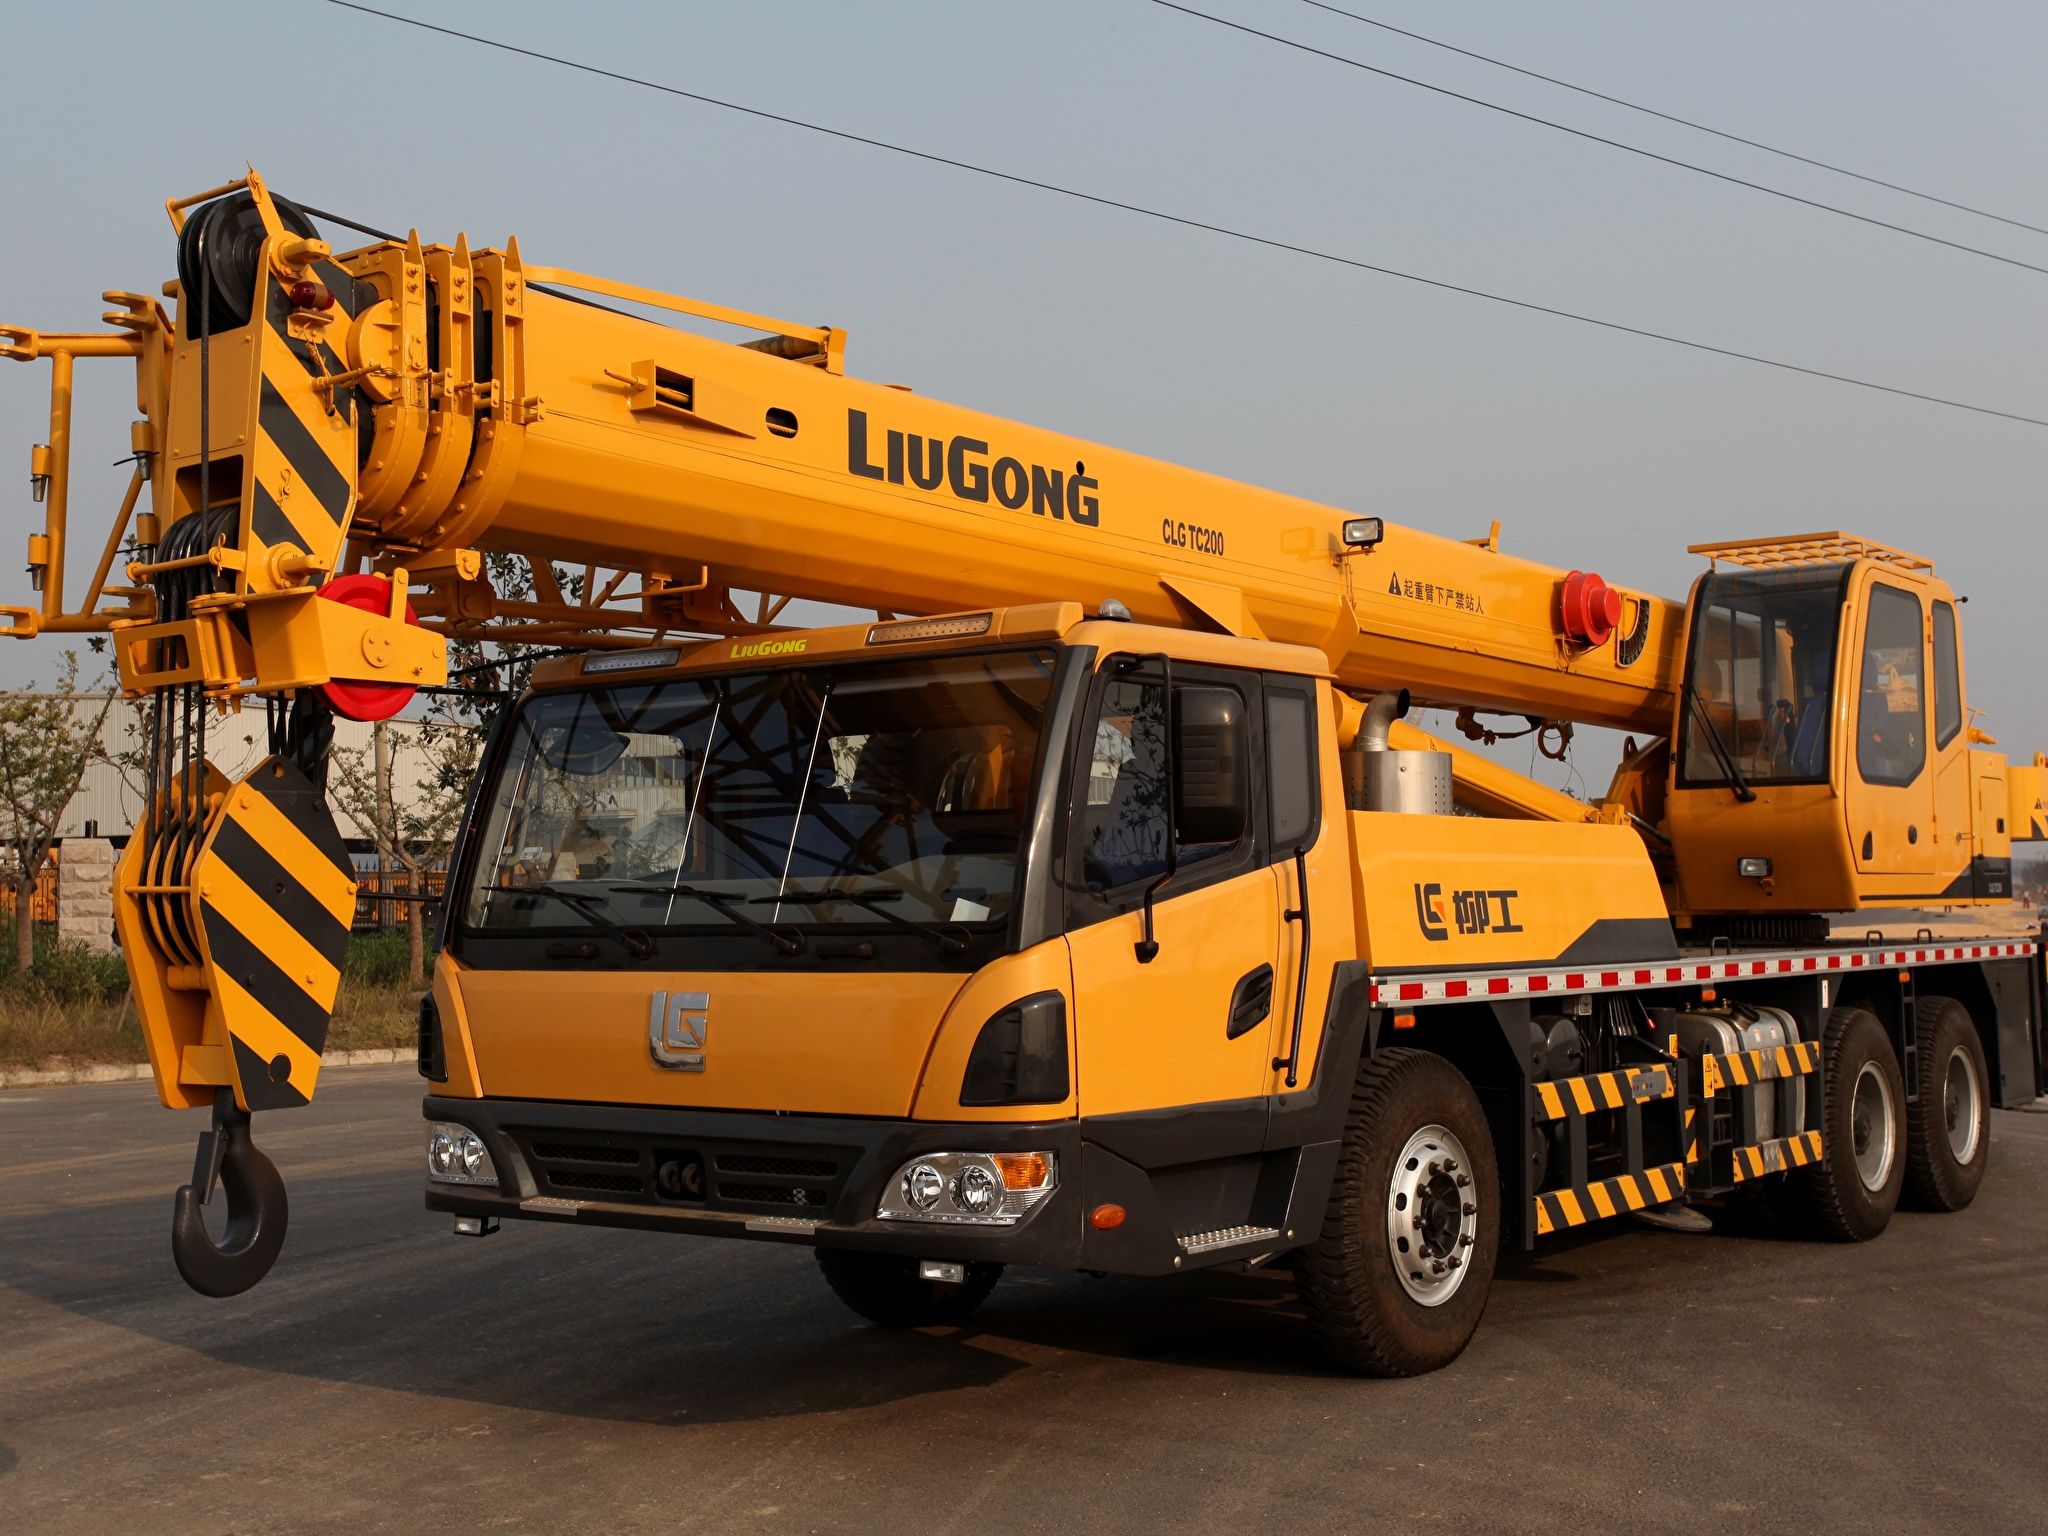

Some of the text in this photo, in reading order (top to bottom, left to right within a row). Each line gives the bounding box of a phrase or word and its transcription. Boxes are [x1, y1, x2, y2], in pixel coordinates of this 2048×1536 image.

[1162, 518, 1224, 557] CLG TC200
[1403, 578, 1484, 614] 起重臂下严禁站人
[1452, 890, 1523, 934] 柳工
